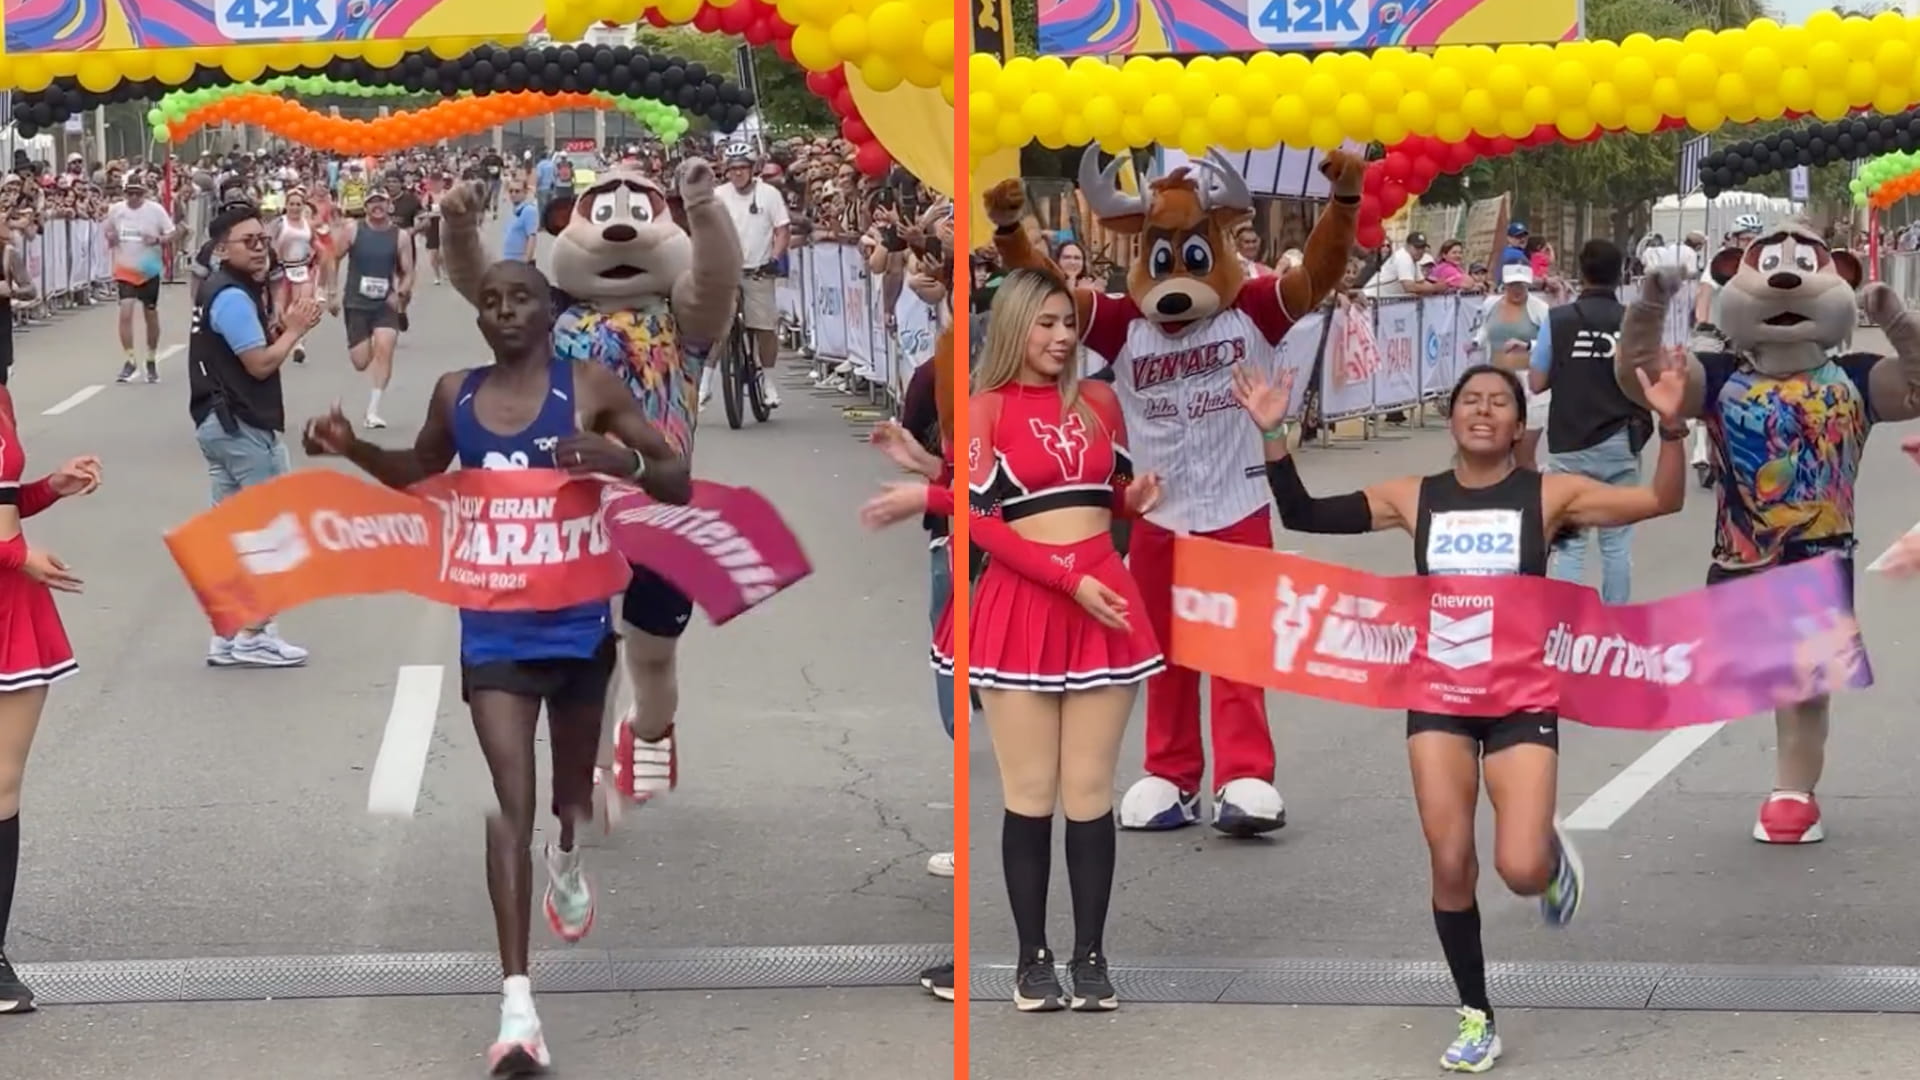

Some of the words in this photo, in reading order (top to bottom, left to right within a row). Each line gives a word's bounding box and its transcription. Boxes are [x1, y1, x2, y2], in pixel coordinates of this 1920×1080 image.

[225, 0, 328, 28] 42K
[1258, 0, 1360, 32] 42K
[1571, 330, 1622, 358] ED
[489, 496, 557, 519] GRAN
[310, 509, 429, 551] Chevron
[1432, 532, 1515, 555] 2082
[1171, 584, 1239, 629] on
[1431, 593, 1495, 609] Chevron
